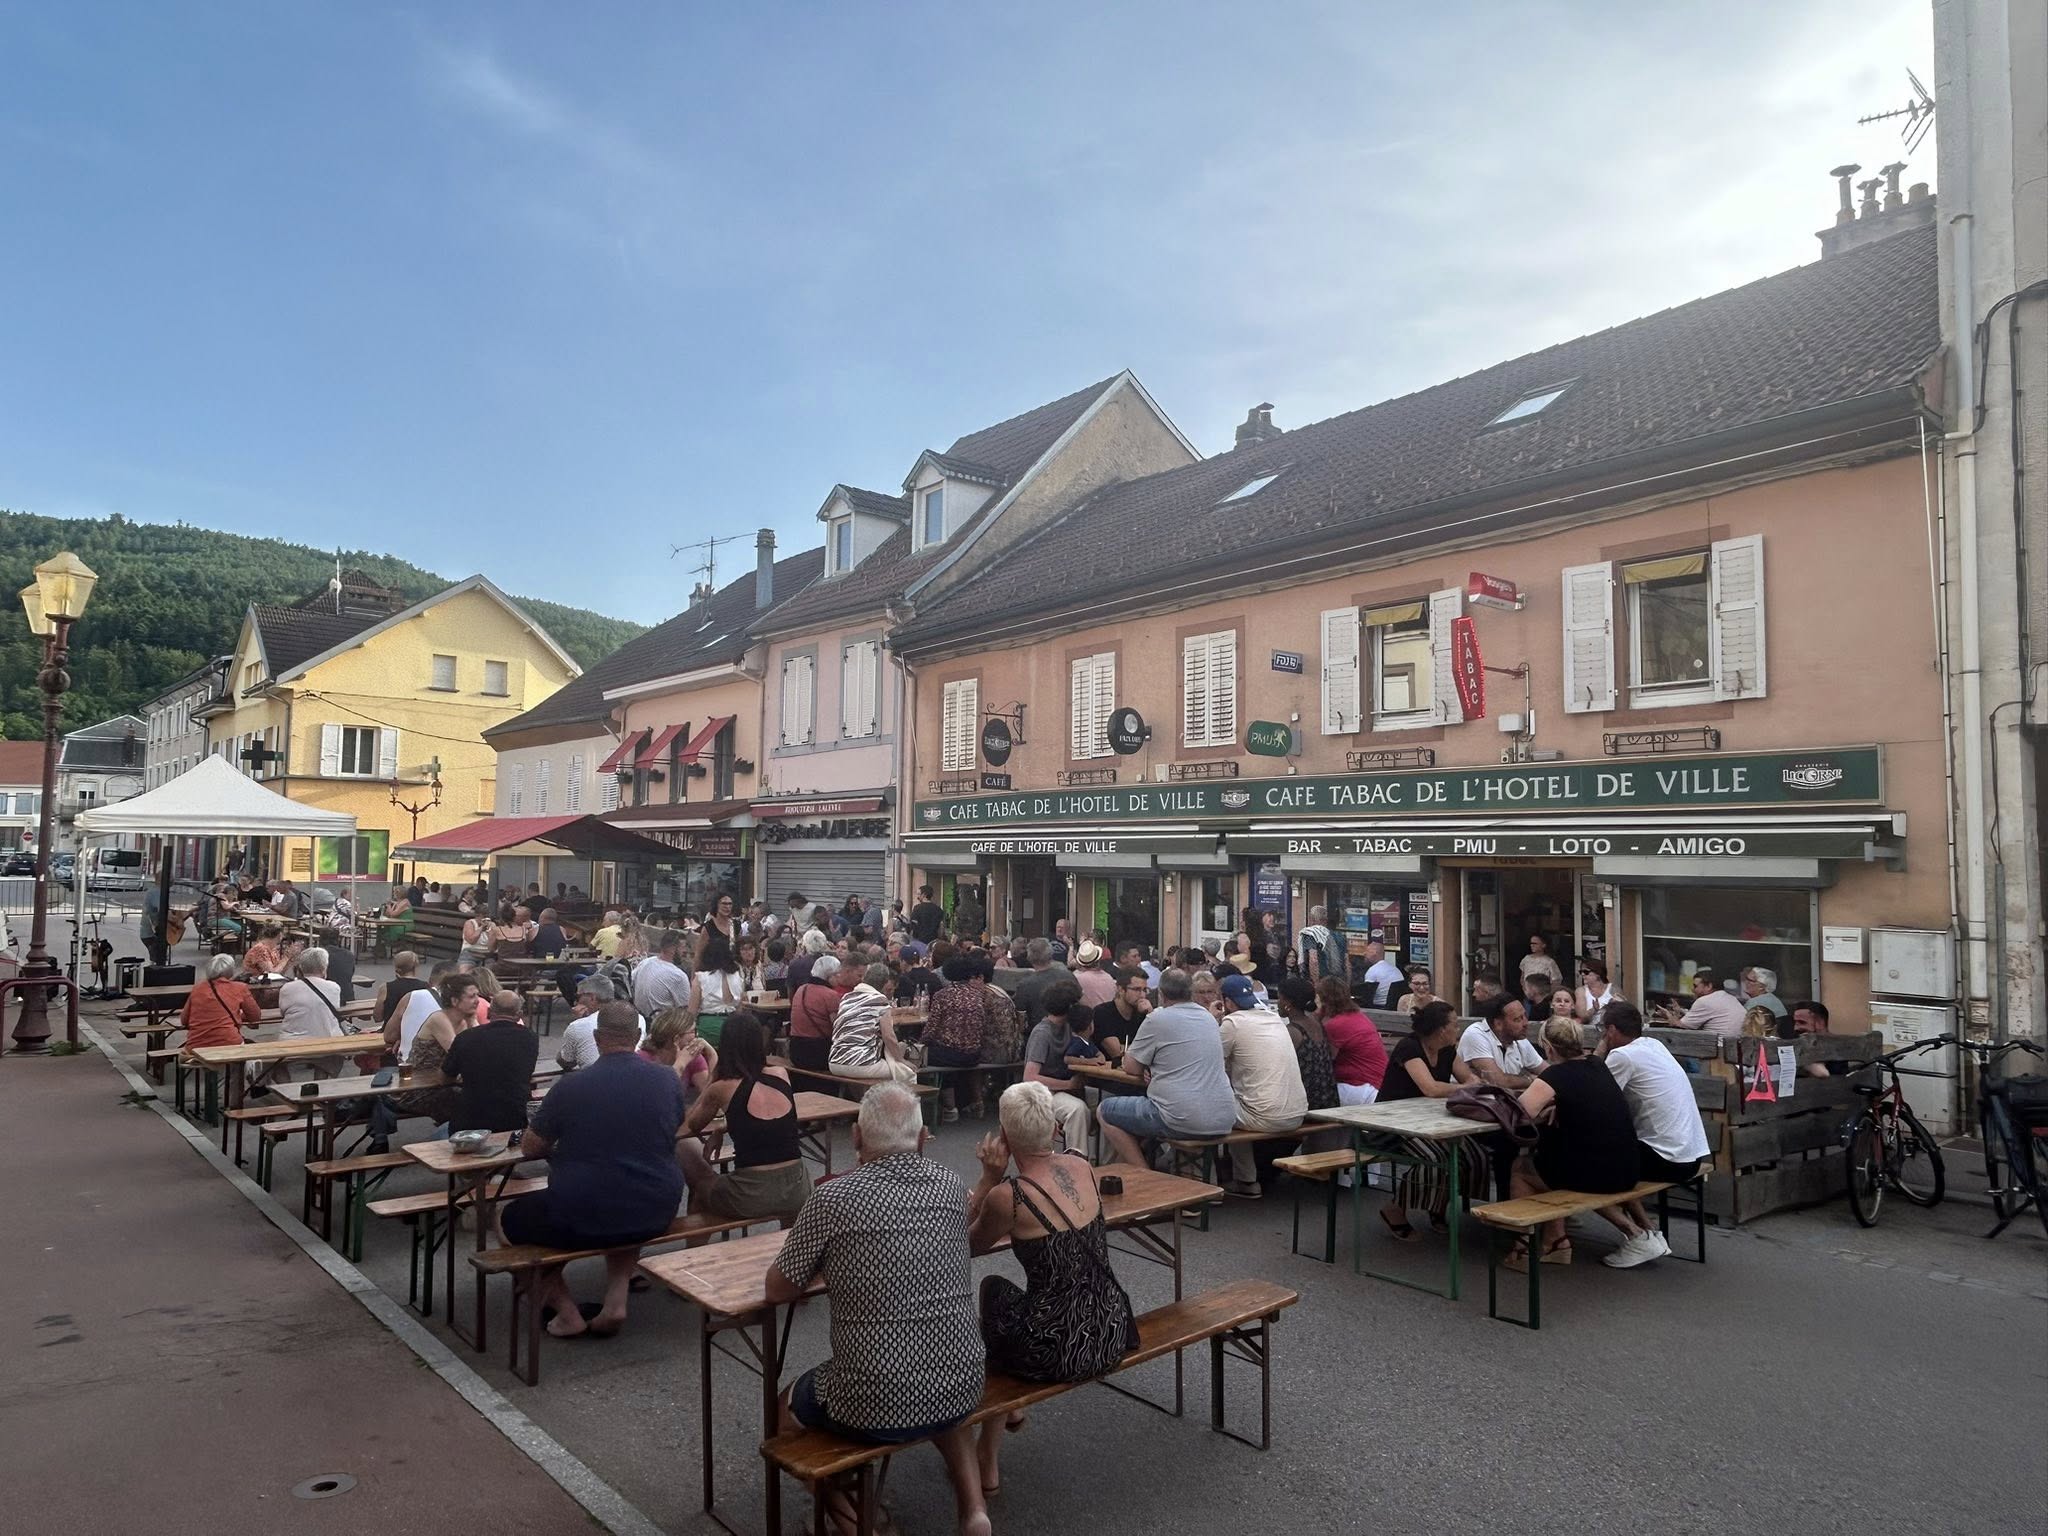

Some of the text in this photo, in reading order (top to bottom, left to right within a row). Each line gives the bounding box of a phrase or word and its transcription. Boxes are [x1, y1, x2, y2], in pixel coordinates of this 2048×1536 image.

[1462, 632, 1479, 705] TABAC
[1250, 732, 1273, 746] PMU
[985, 775, 1008, 787] CAFÉ
[1265, 767, 1751, 807] CAFE TABAC DE L'HOTEL DE VILLE
[949, 791, 1206, 820] CAFE TABAC DE L'HOTEL DE VILLE
[971, 841, 1117, 853] CAFE DE L'HOTEL DE VILLE
[1288, 839, 1321, 854] BAR
[1352, 838, 1412, 853] TABAC
[1454, 838, 1497, 854] PMU
[1549, 838, 1611, 855] LOTO
[1657, 837, 1746, 855] AMIGO
